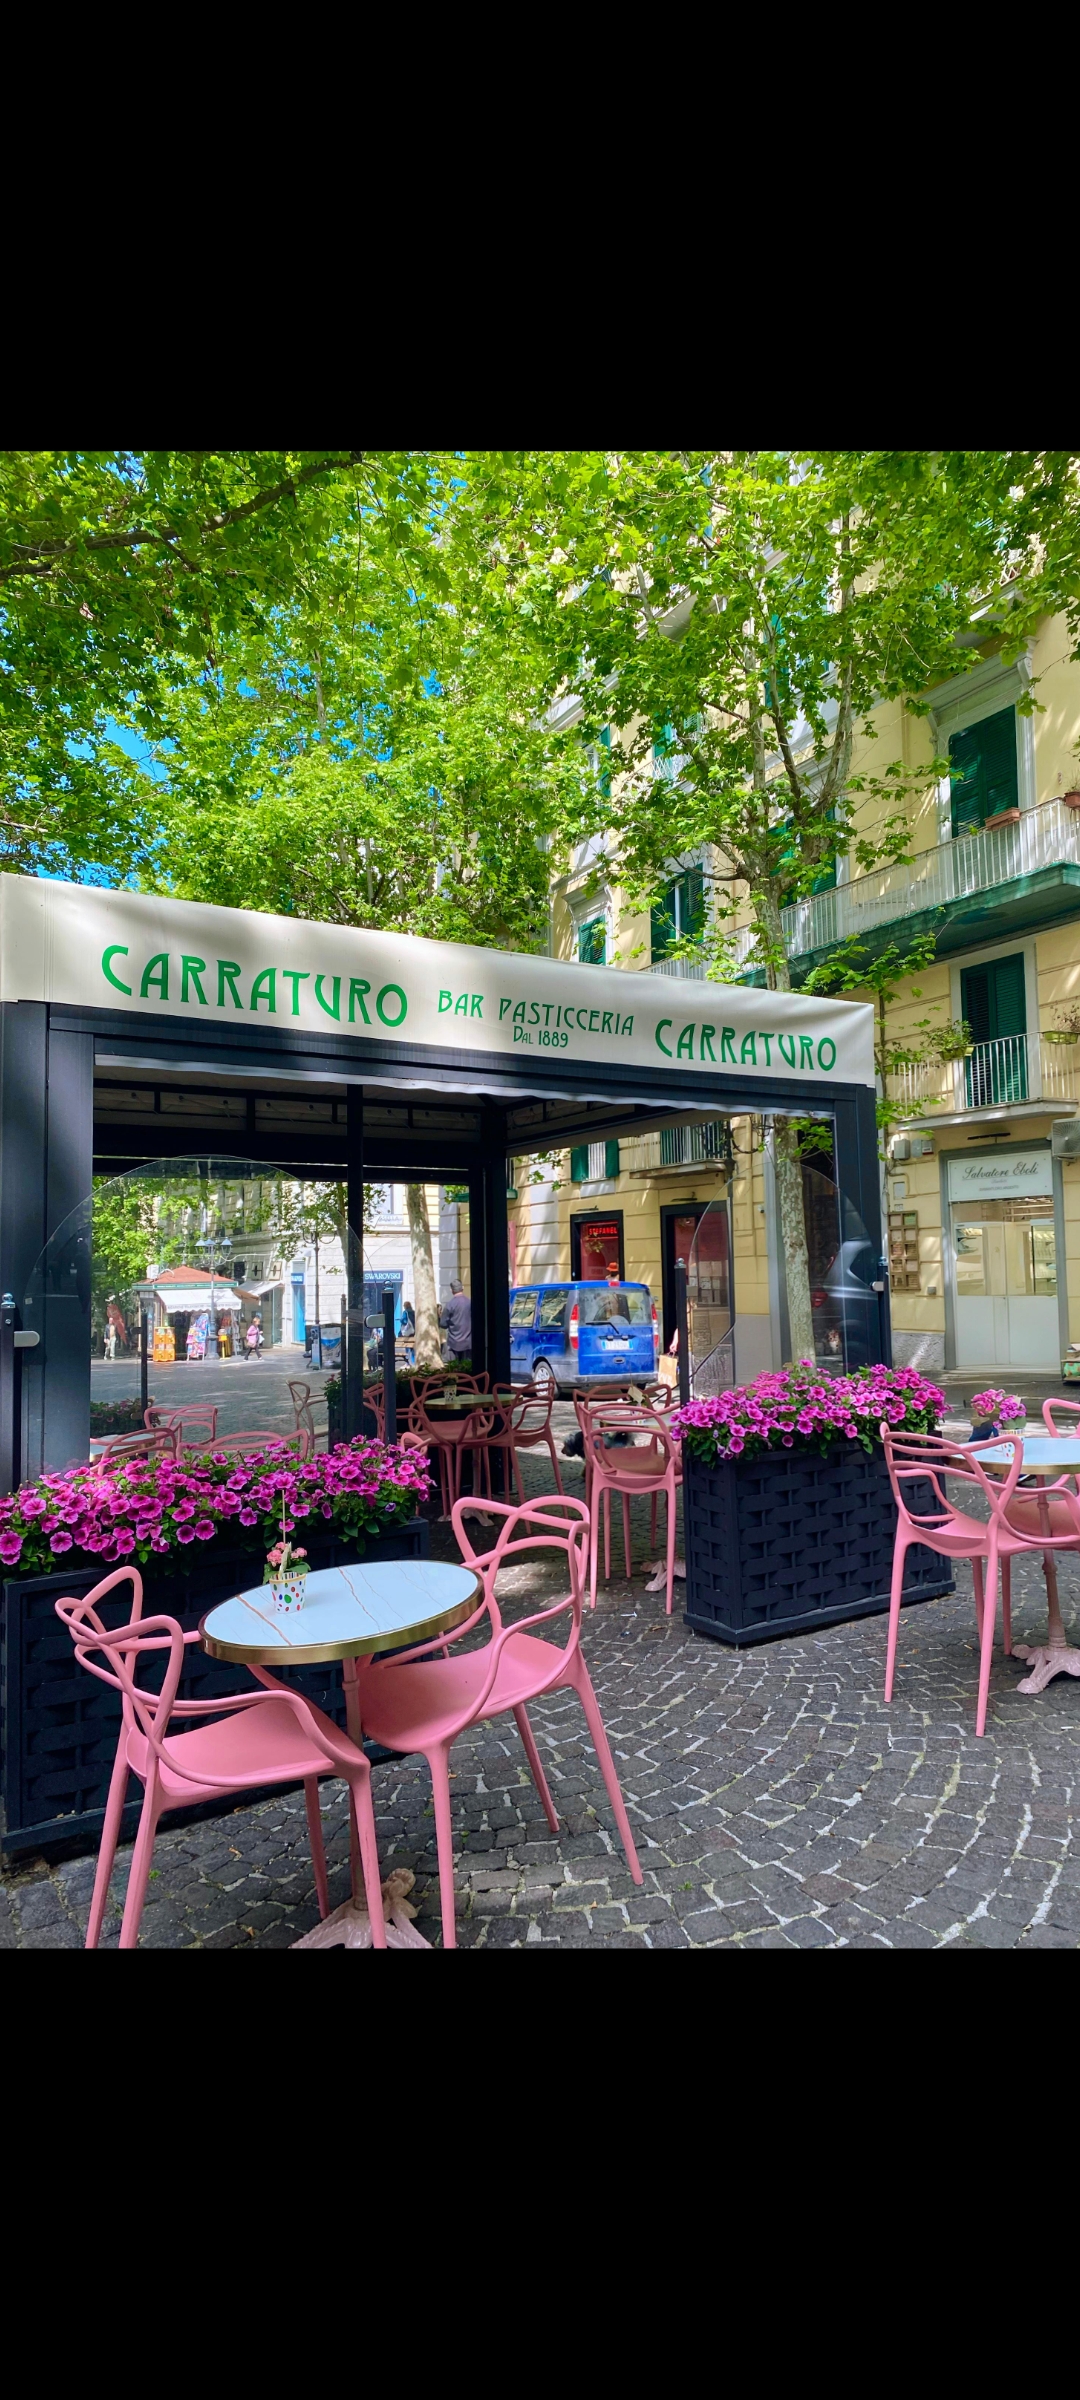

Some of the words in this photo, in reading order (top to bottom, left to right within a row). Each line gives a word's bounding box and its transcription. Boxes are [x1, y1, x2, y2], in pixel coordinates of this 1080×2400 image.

[101, 944, 408, 1027] CARRATURO
[437, 989, 484, 1018] BAR
[498, 997, 634, 1036] PASTICCERIA
[538, 1030, 569, 1048] 1889
[655, 1018, 837, 1071] CARRATURO
[962, 1165, 1009, 1180] Salvatore
[1013, 1161, 1039, 1176] Eboli
[364, 1272, 401, 1280] SWAROVSKI
